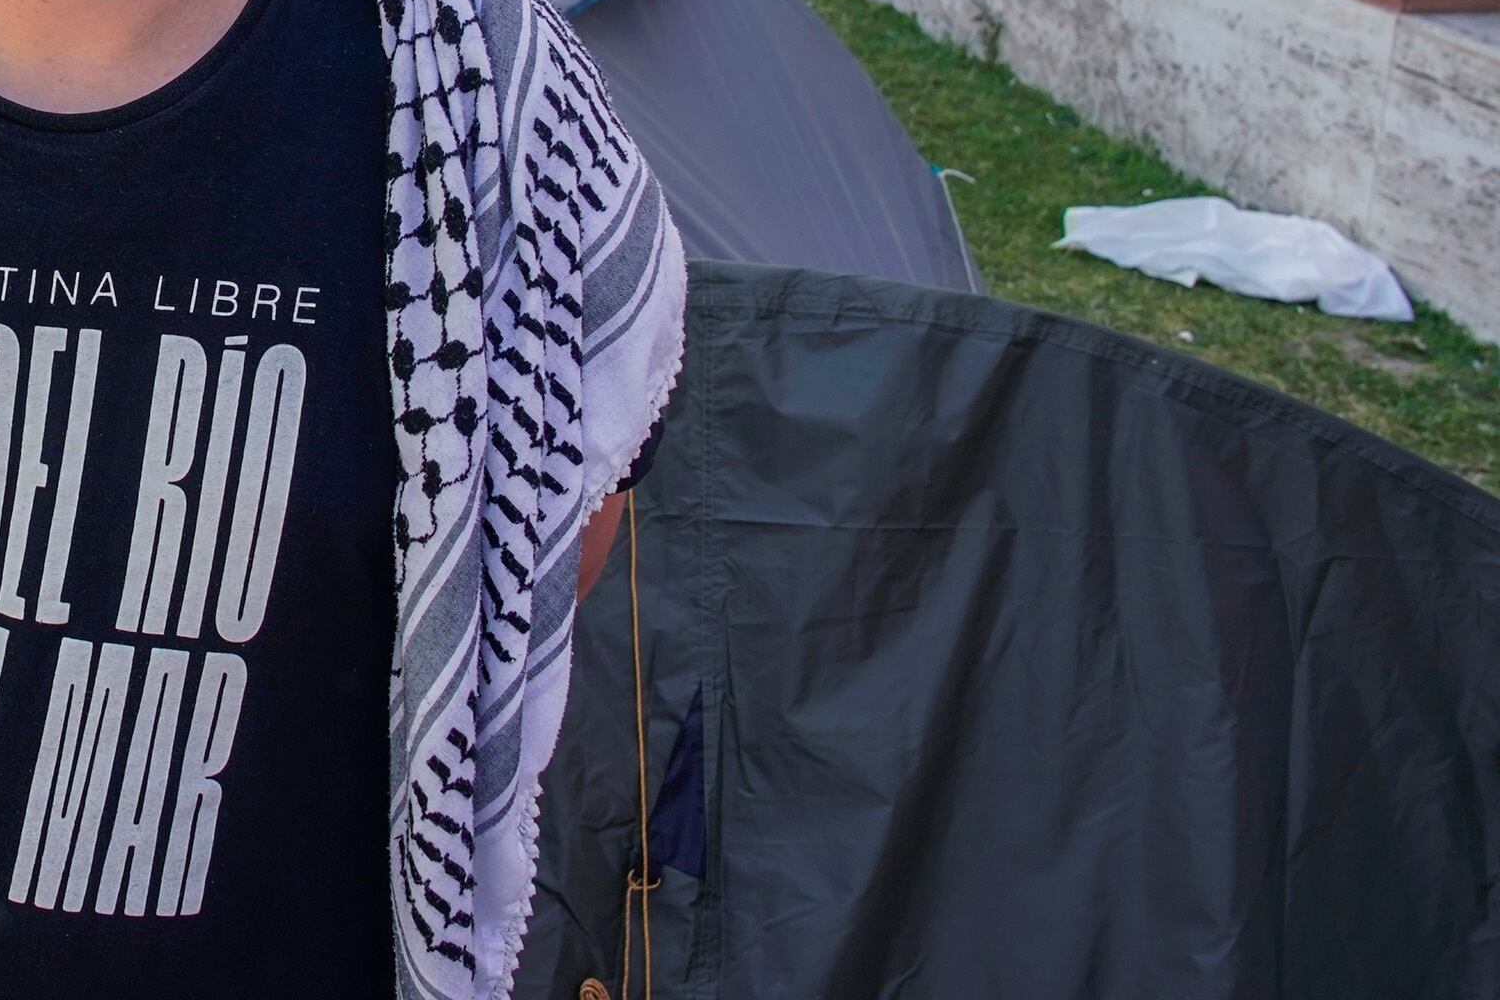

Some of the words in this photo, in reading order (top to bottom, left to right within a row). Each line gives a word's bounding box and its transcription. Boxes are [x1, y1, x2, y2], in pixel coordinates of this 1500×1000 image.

[153, 275, 321, 325] LIBRE
[114, 334, 307, 643] RÍO
[7, 637, 248, 917] MAR
